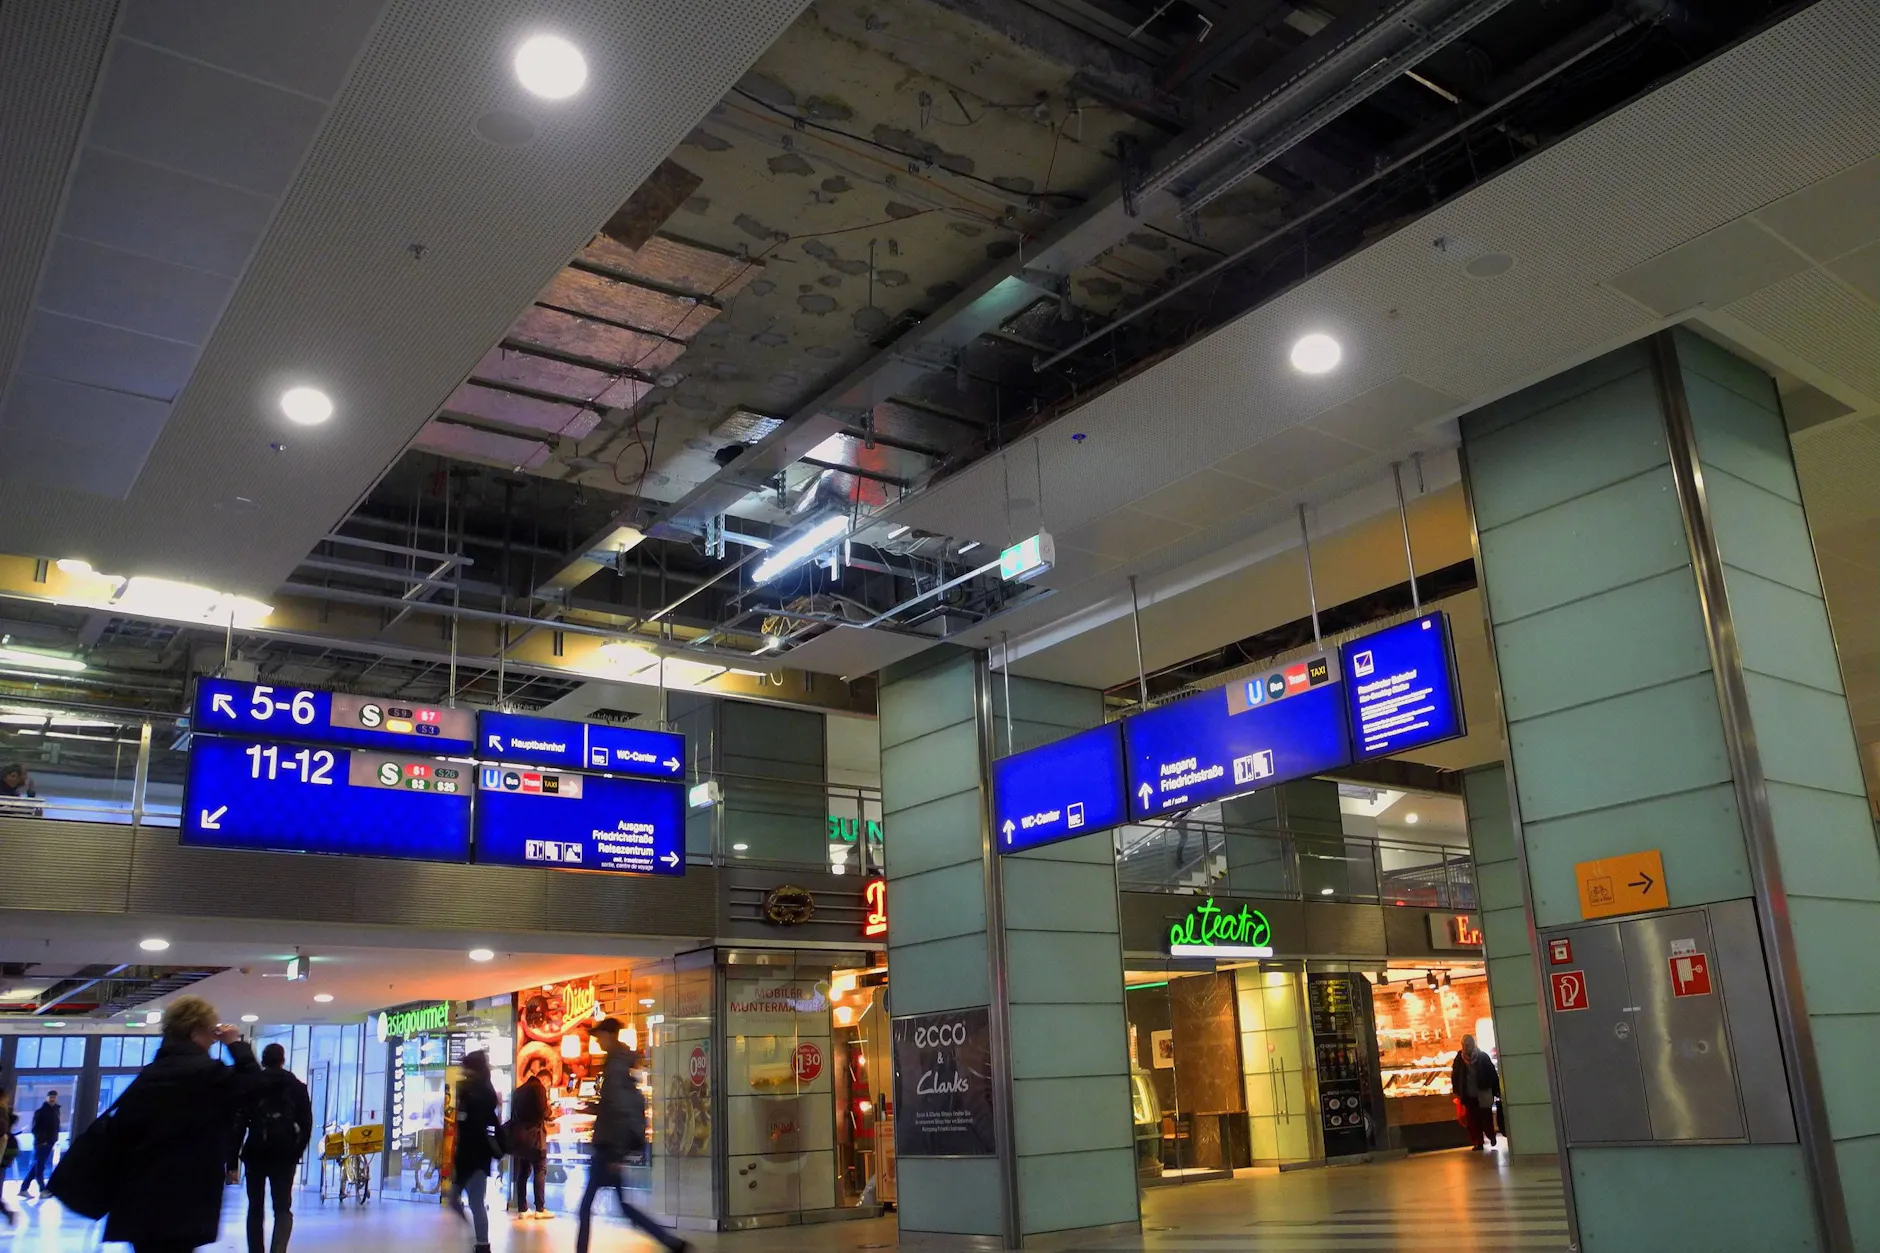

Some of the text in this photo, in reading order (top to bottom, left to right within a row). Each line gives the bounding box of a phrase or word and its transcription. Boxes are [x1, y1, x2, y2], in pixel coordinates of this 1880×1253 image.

[1310, 665, 1326, 678] TAXI
[1248, 680, 1263, 705] U
[250, 685, 316, 726] 5-6
[361, 704, 381, 728] S
[420, 711, 435, 721] S7
[421, 725, 435, 735] S3
[510, 738, 566, 754] Hauptbahnhof
[246, 744, 335, 786] 11-12
[616, 749, 658, 764] WC-Center
[380, 762, 399, 786] S
[412, 765, 425, 776] S1
[1160, 757, 1197, 777] Ausgang
[411, 779, 425, 790] S2
[485, 769, 499, 788] U
[544, 780, 558, 789] TAXI
[1160, 765, 1224, 792] Friedrichstraße
[617, 820, 655, 835] Ausgang
[1021, 809, 1061, 829] WC-Center
[592, 830, 654, 845] Friedrichstraße
[597, 842, 654, 857] Reisezentrum
[1455, 914, 1483, 945] Er
[562, 979, 595, 1024] Ditsch
[754, 987, 804, 999] MOBILER
[387, 1000, 450, 1040] asiagourmet
[914, 1022, 966, 1049] ecco
[937, 1051, 944, 1064] &
[916, 1070, 969, 1095] Clarks
